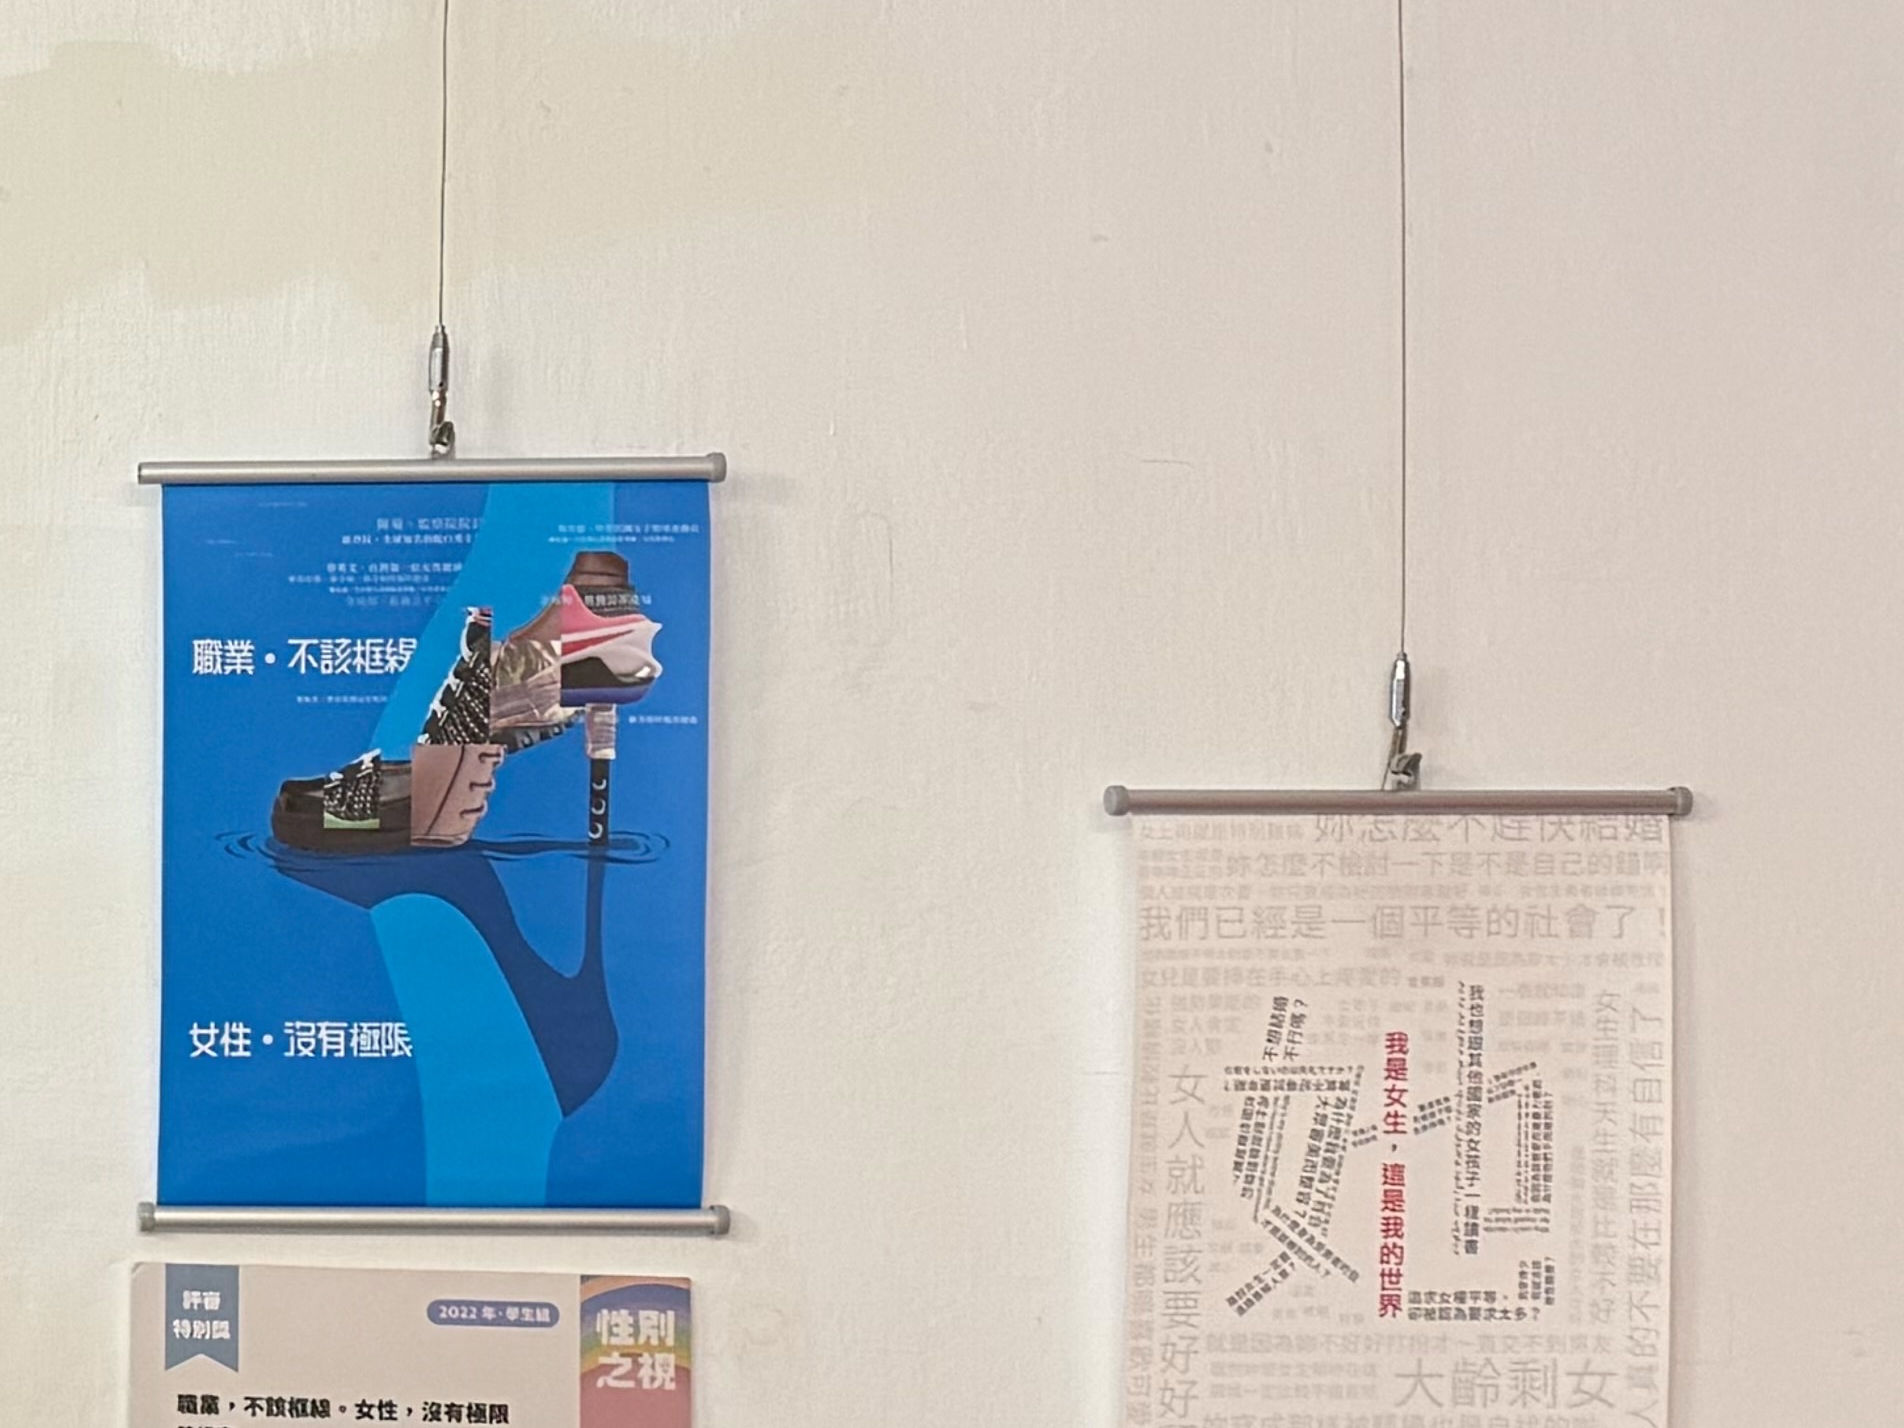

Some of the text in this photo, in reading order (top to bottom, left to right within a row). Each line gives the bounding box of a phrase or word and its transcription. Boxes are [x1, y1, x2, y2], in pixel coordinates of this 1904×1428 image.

[1378, 1030, 1409, 1318] 我是女生，這是我的世界
[595, 1308, 676, 1348] 性別
[596, 1353, 676, 1391] 之視
[1395, 1358, 1618, 1410] 大齡剩女
